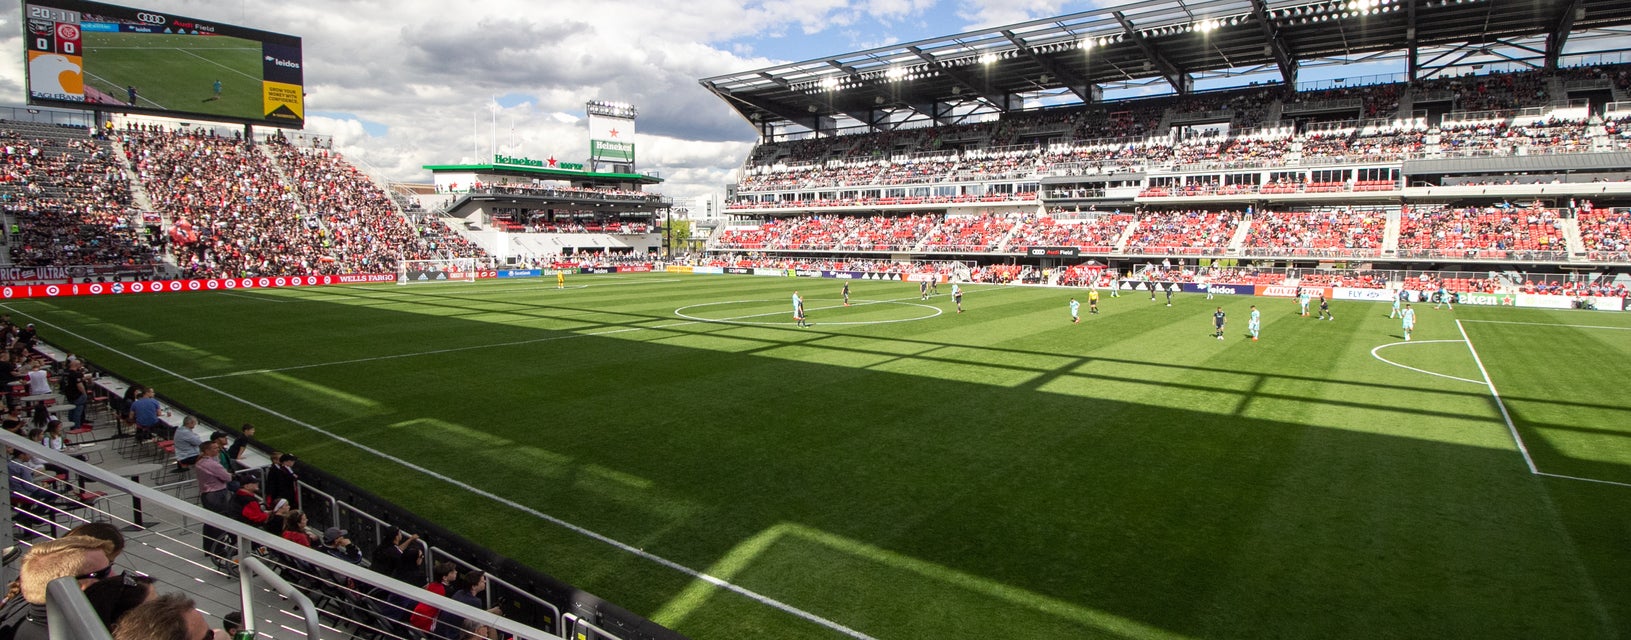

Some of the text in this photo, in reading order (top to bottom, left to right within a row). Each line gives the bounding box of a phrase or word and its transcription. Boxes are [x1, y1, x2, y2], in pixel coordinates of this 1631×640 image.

[31, 7, 75, 22] 20:11
[173, 20, 215, 32] Audi Field
[36, 38, 48, 50] 0
[63, 41, 75, 54] 0
[275, 58, 300, 69] leidos
[596, 141, 632, 151] Heineken
[494, 154, 543, 166] Heineken
[36, 266, 69, 280] ULTRAS
[368, 274, 394, 282] FARGO
[1348, 290, 1363, 298] FLY
